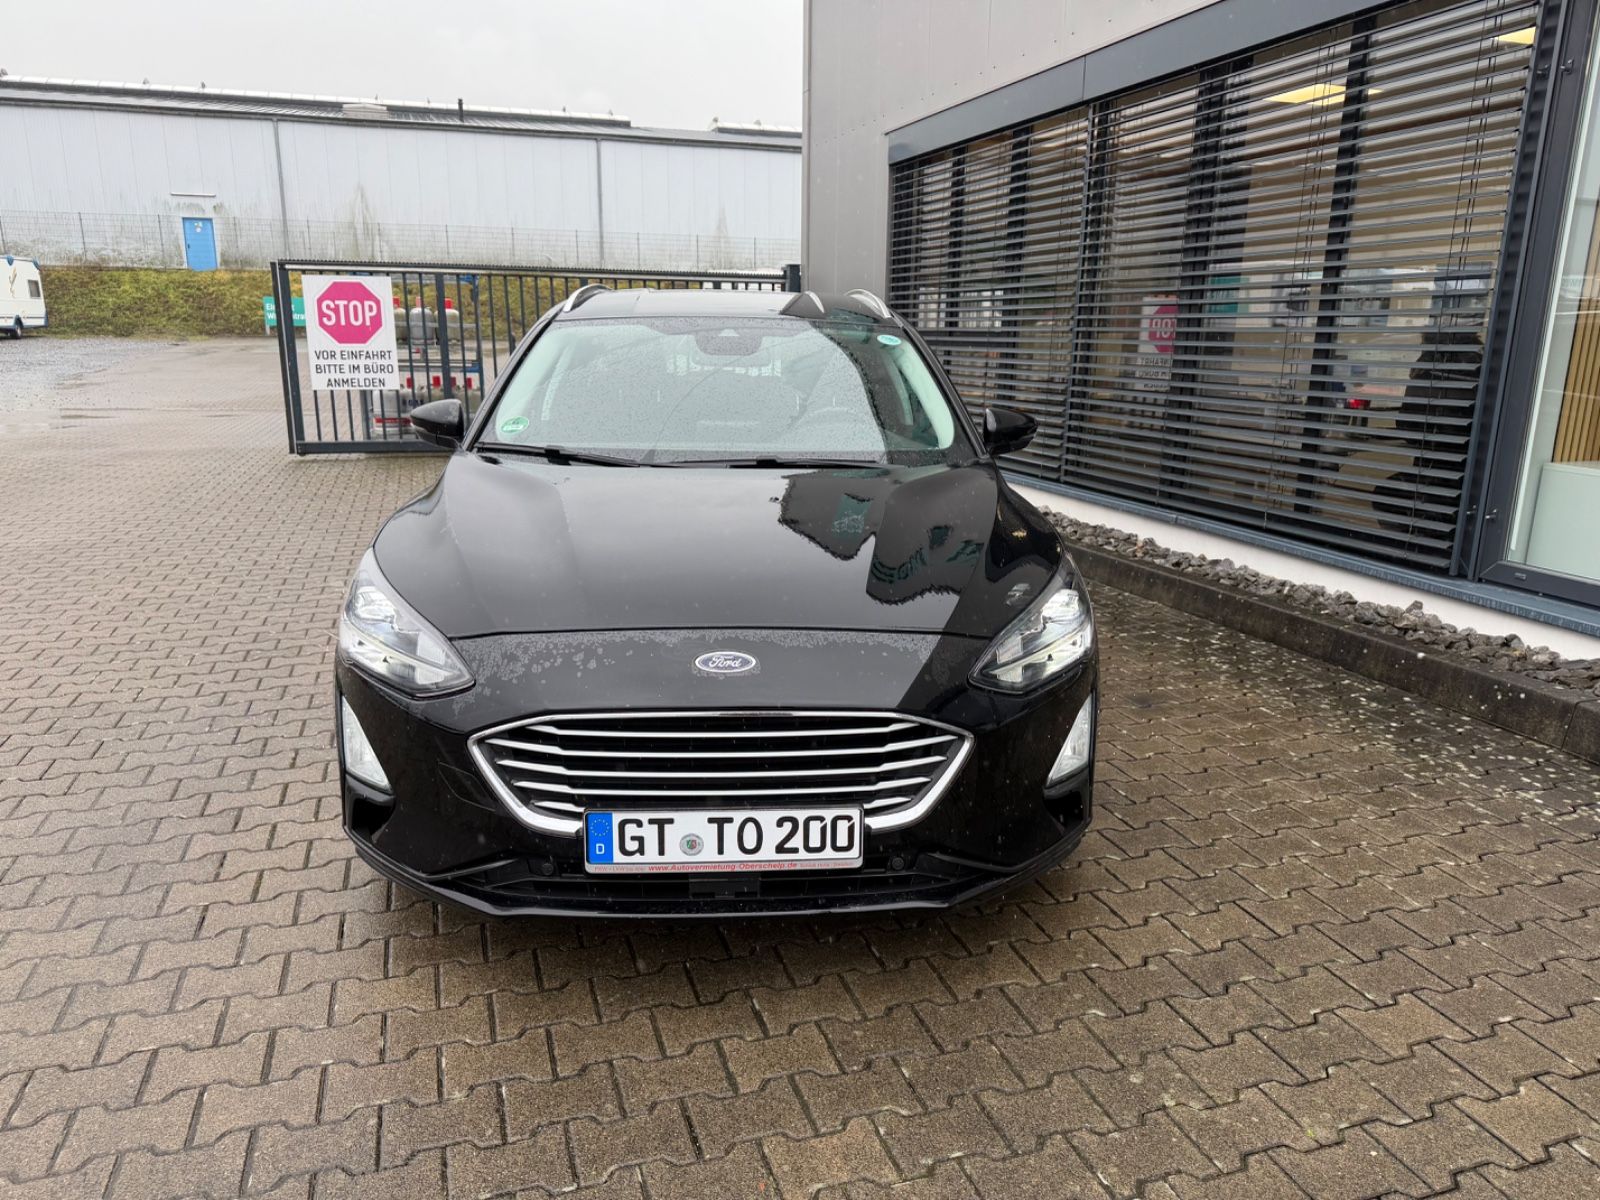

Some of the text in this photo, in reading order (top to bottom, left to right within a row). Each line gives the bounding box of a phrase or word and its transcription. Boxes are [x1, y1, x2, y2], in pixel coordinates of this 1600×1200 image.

[321, 299, 378, 327] STOP
[314, 350, 392, 361] VOR EINFAHRT
[315, 362, 394, 374] BITTE IM BÜRO
[326, 378, 386, 388] ANMELDEN
[709, 655, 742, 667] Ford
[618, 815, 855, 857] GT TO 200
[596, 843, 605, 855] D
